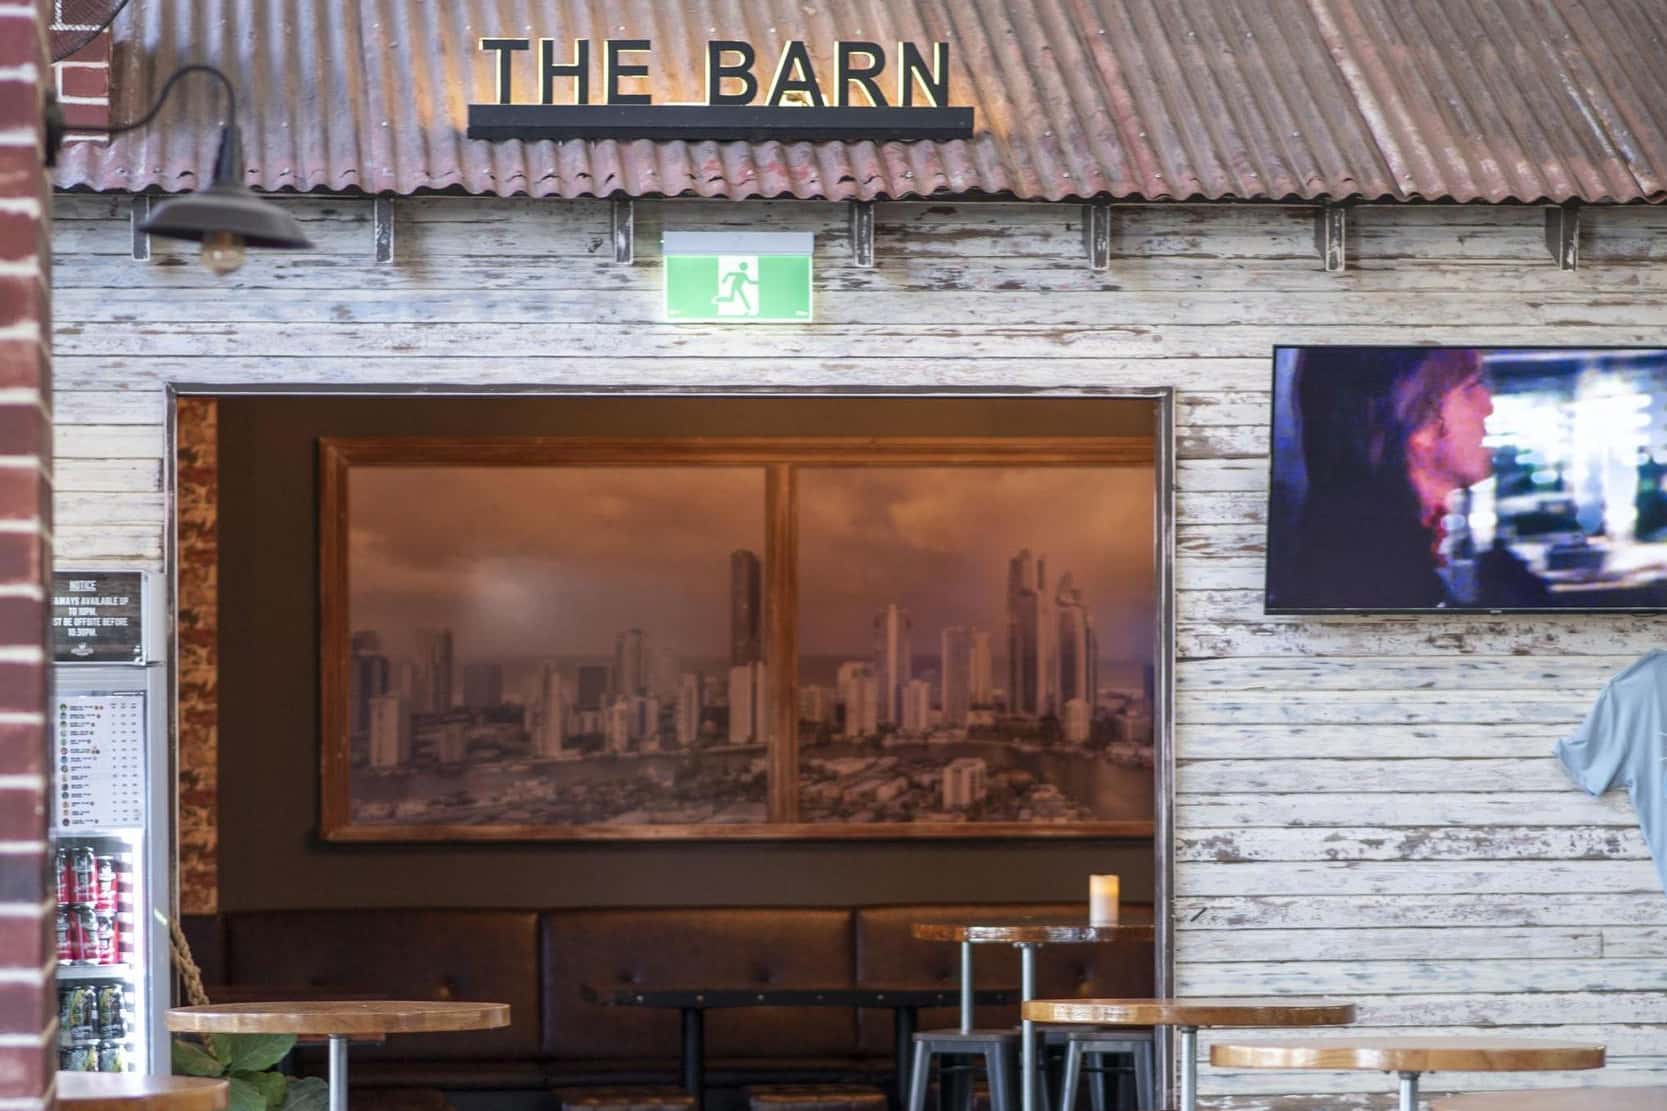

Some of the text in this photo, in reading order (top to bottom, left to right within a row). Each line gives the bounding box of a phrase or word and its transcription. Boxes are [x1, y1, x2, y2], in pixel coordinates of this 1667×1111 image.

[479, 38, 950, 107] THE BARN
[69, 580, 97, 591] NOTICE
[53, 597, 79, 606] AWAYS
[80, 597, 118, 606] AVAILABLE
[52, 617, 62, 626] ST
